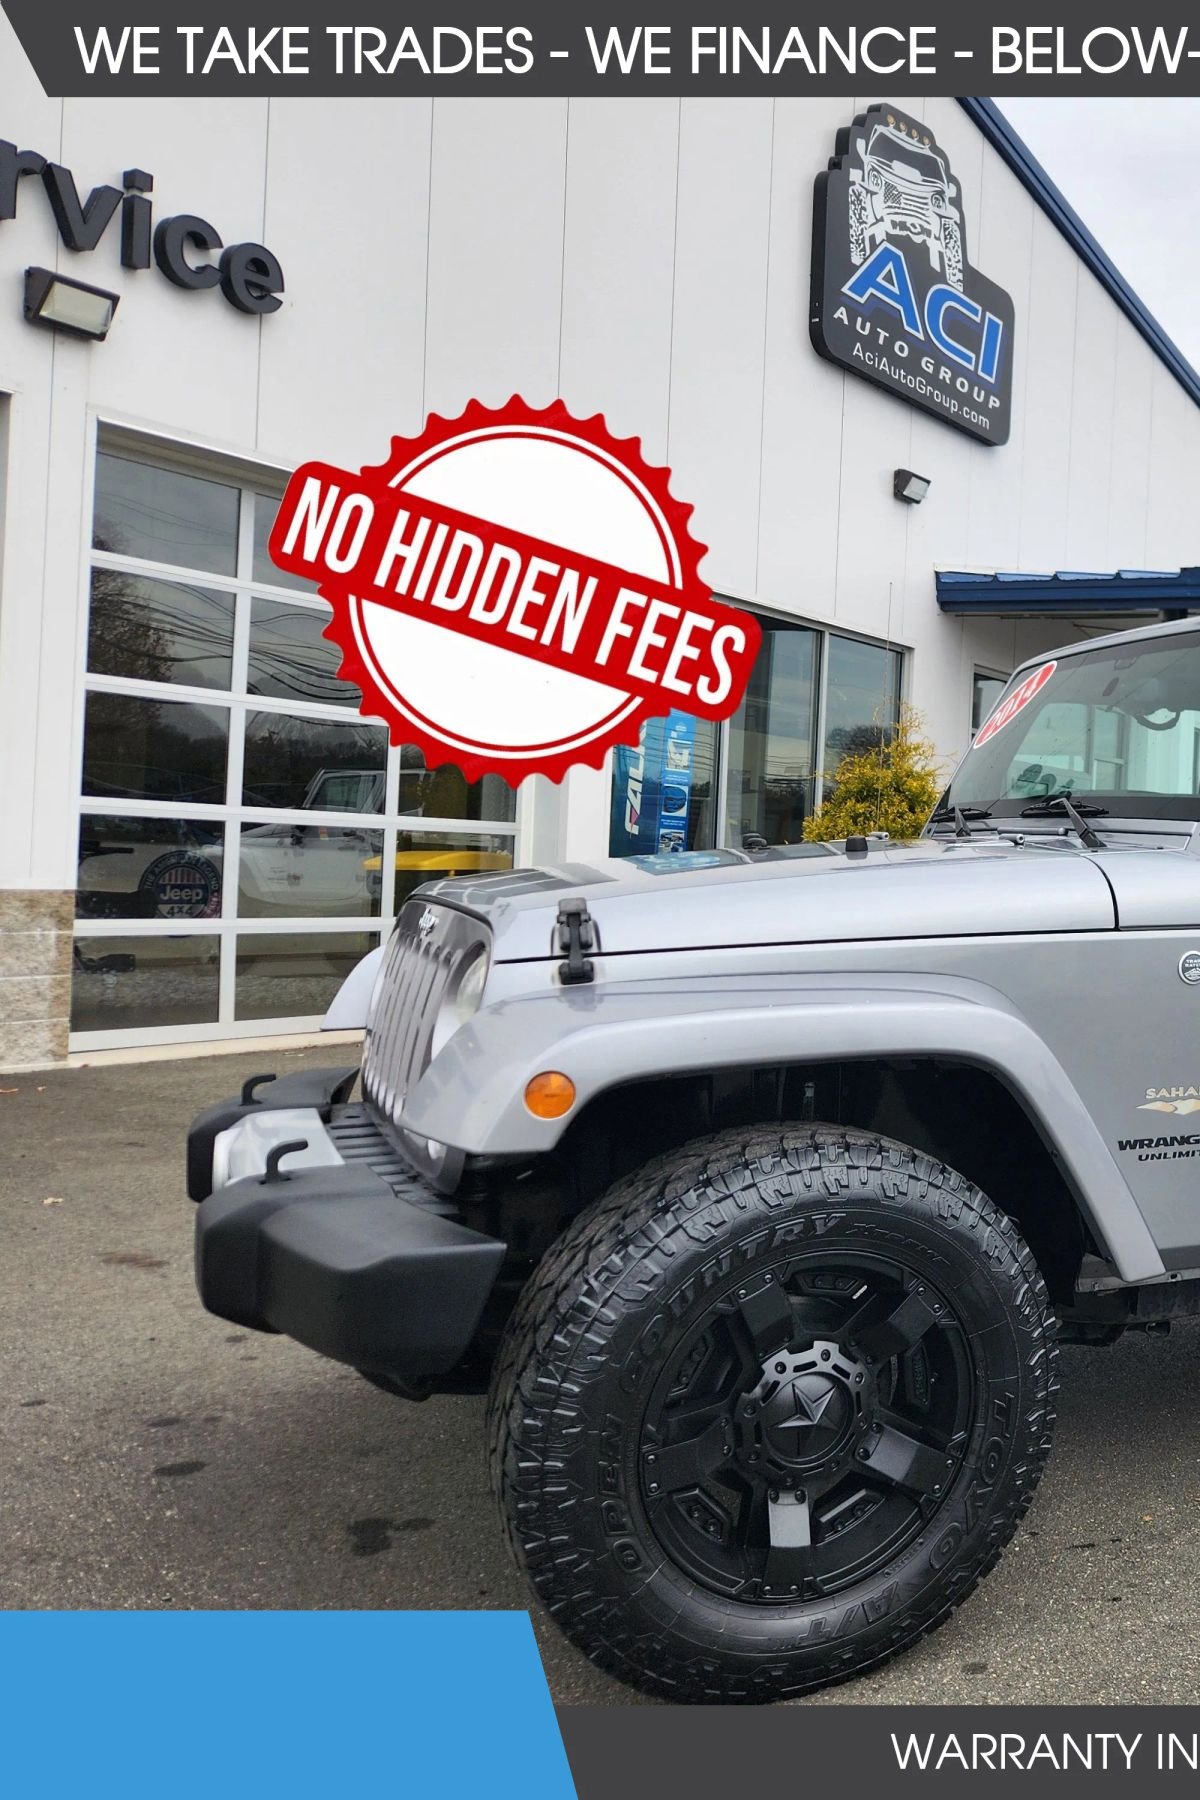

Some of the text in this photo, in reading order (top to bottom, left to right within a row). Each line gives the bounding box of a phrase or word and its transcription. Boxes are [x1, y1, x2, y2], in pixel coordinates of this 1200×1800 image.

[833, 306, 1001, 410] AUTO GROUP
[840, 240, 1004, 385] ACI
[852, 342, 990, 430] AciAutoGroup.com
[160, 885, 204, 904] Jeep
[929, 1391, 1017, 1571] TOYO
